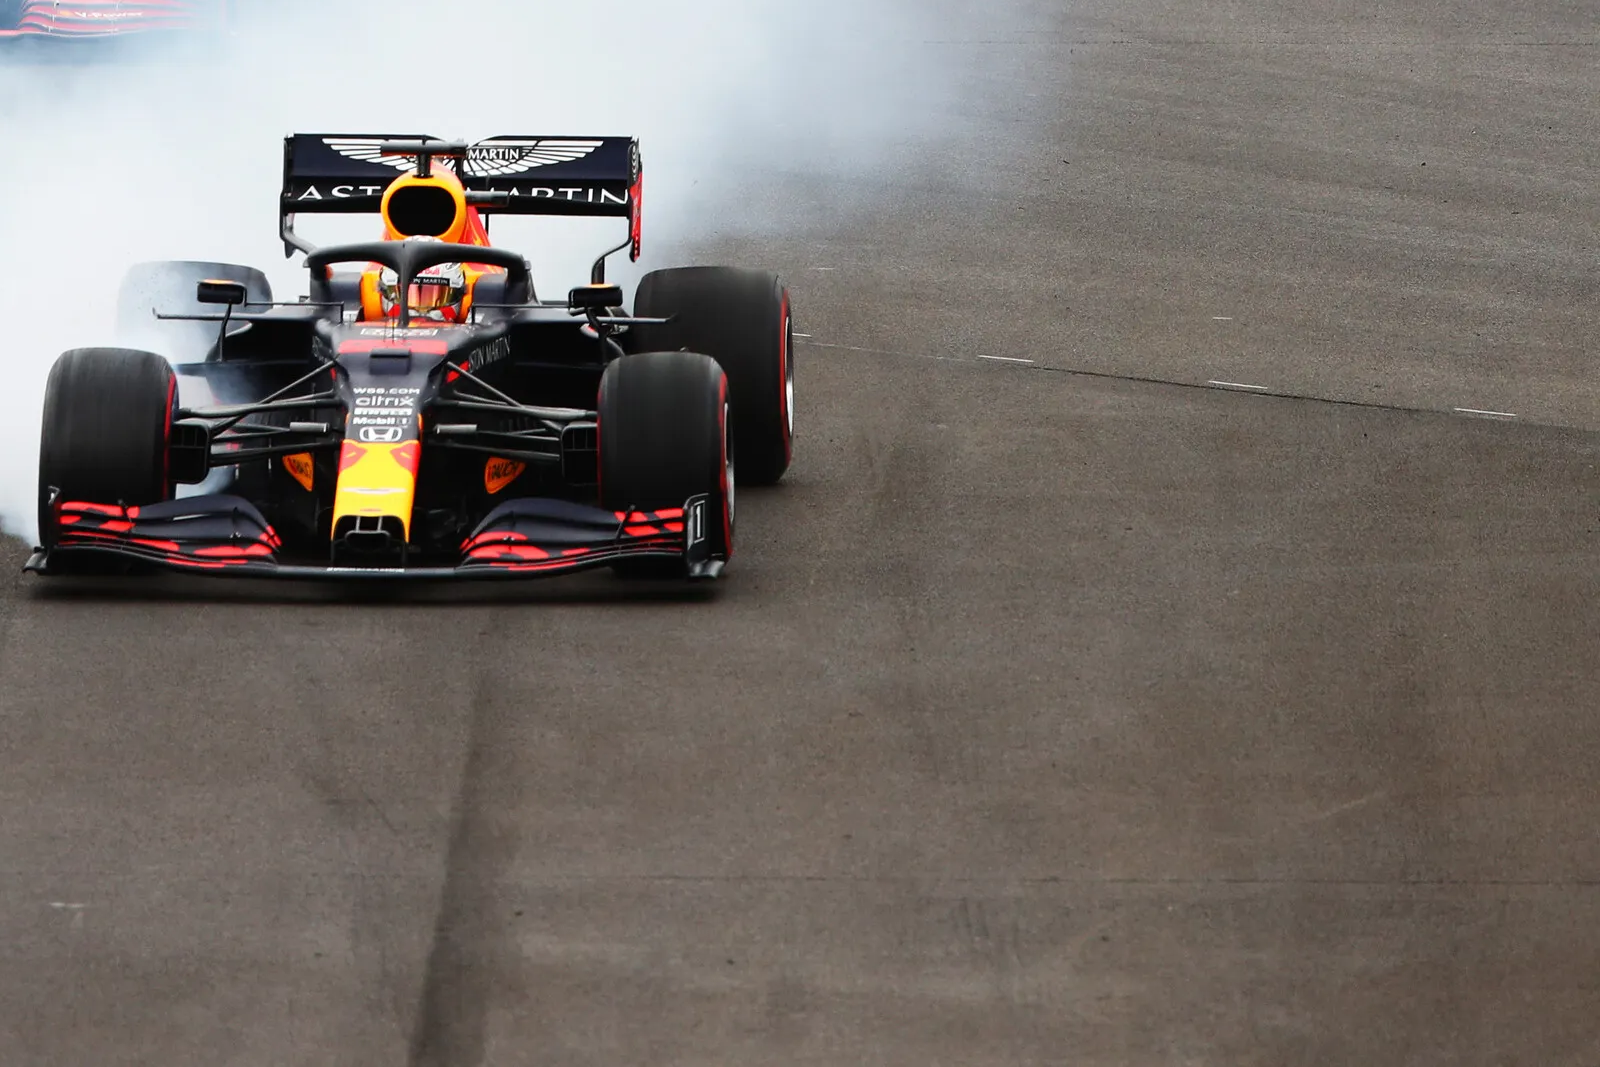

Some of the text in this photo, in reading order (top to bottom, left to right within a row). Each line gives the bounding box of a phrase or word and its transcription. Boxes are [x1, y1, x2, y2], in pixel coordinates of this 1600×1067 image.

[468, 148, 519, 160] MARTIN
[297, 185, 382, 201] AST
[353, 416, 395, 425] Mobil
